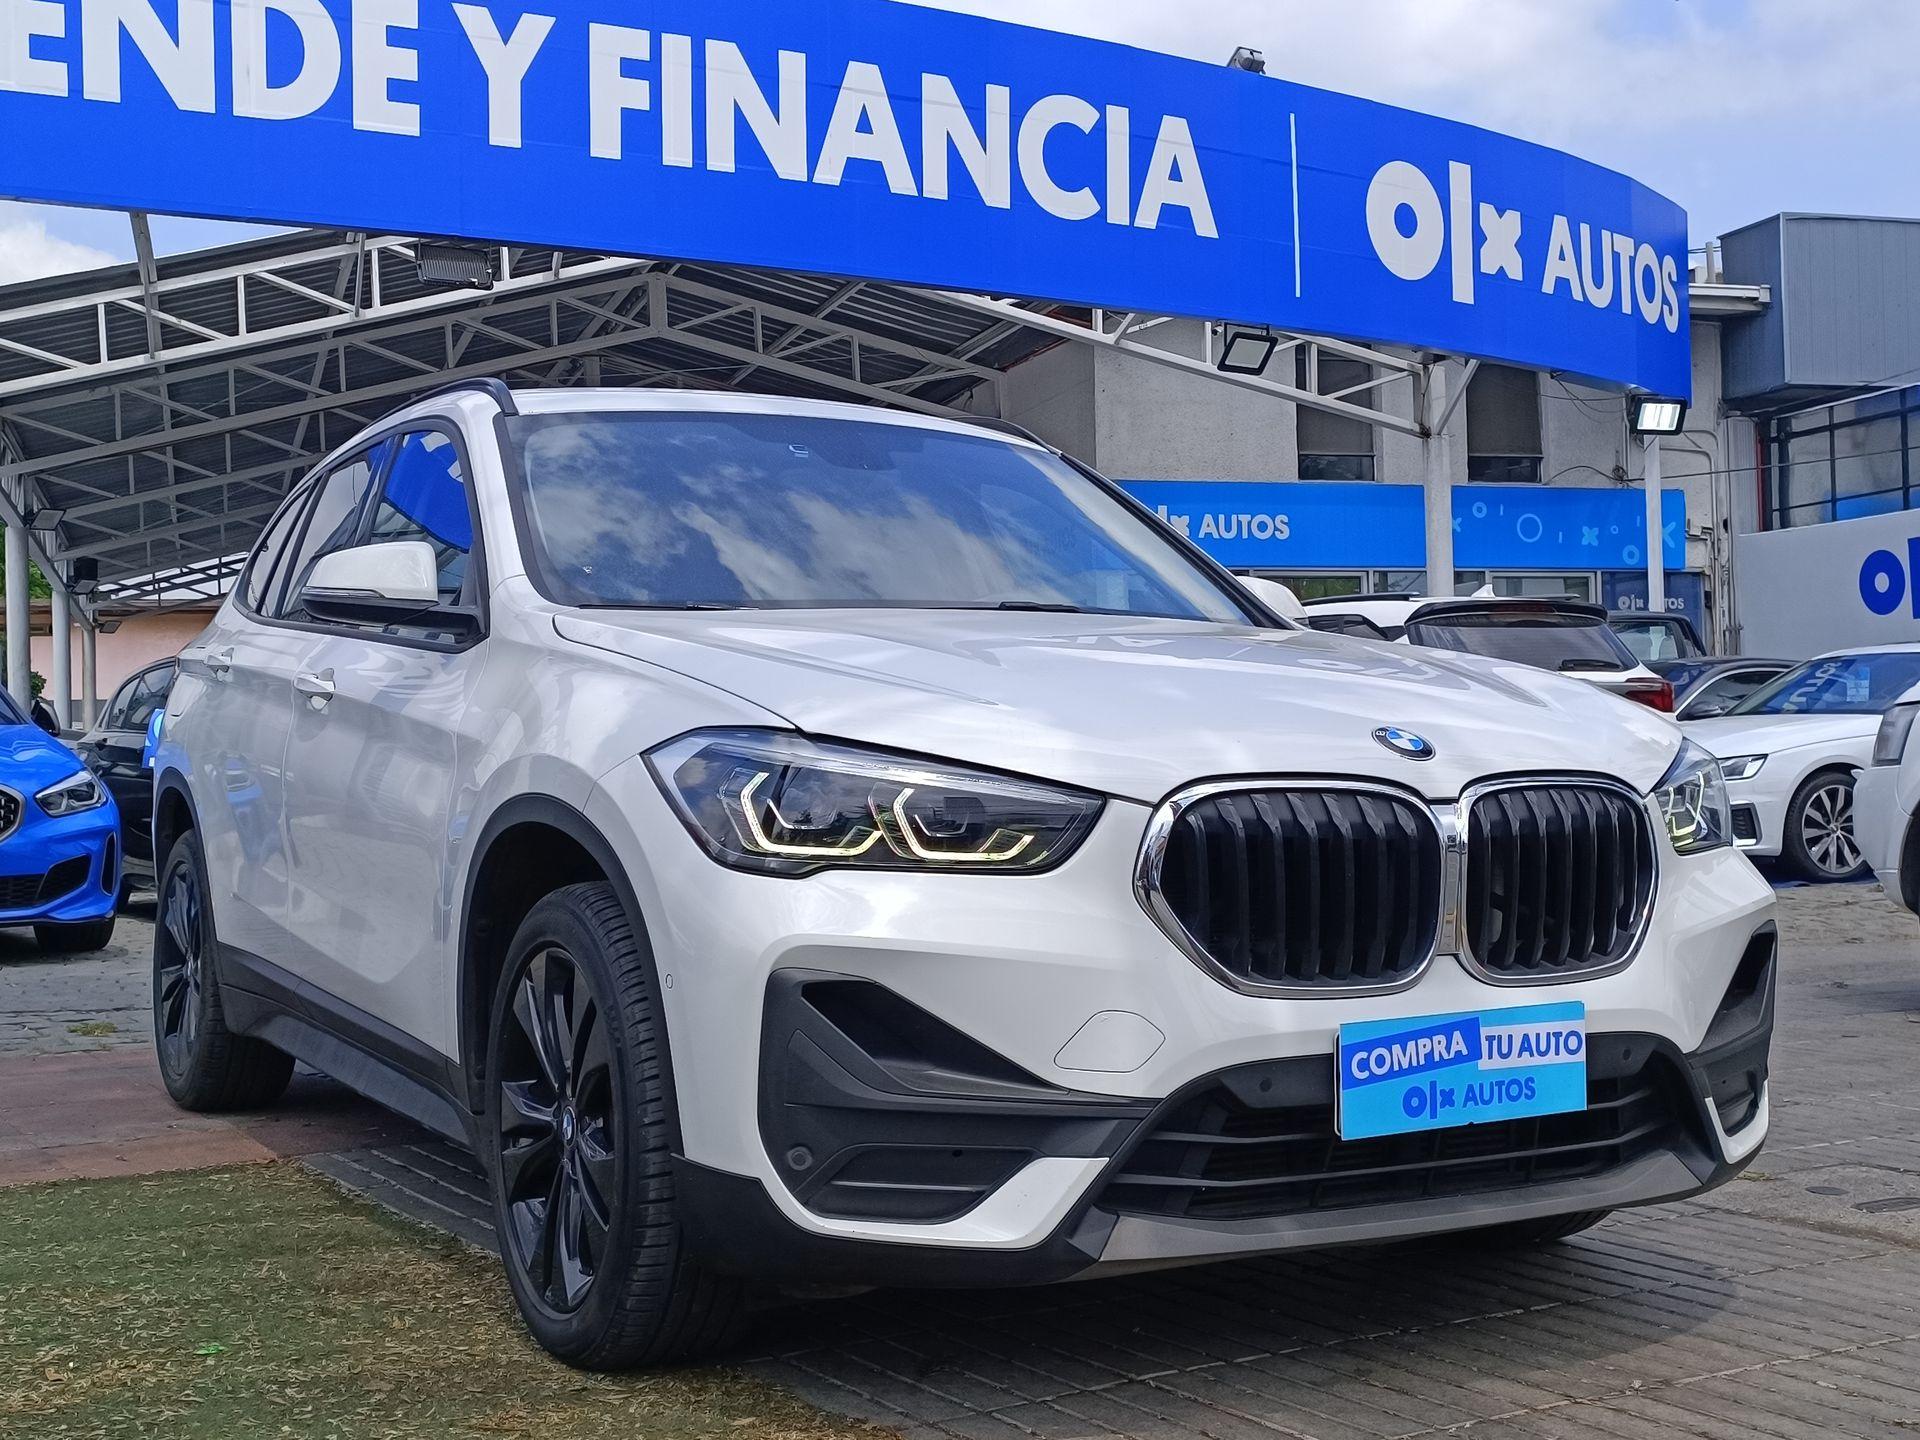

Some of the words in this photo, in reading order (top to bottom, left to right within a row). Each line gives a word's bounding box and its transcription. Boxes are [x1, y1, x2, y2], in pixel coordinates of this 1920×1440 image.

[452, 2, 557, 148] Y
[589, 22, 1219, 238] FINANCIA
[1365, 159, 1523, 305] olx
[1541, 214, 1679, 334] AUTOS
[1198, 513, 1290, 540] AUTOS
[1351, 1030, 1468, 1080] COMPRA
[1485, 1034, 1513, 1060] TU
[1517, 1030, 1583, 1057] AUTO
[1402, 1080, 1454, 1120] olx
[1462, 1076, 1536, 1108] AUTOS
